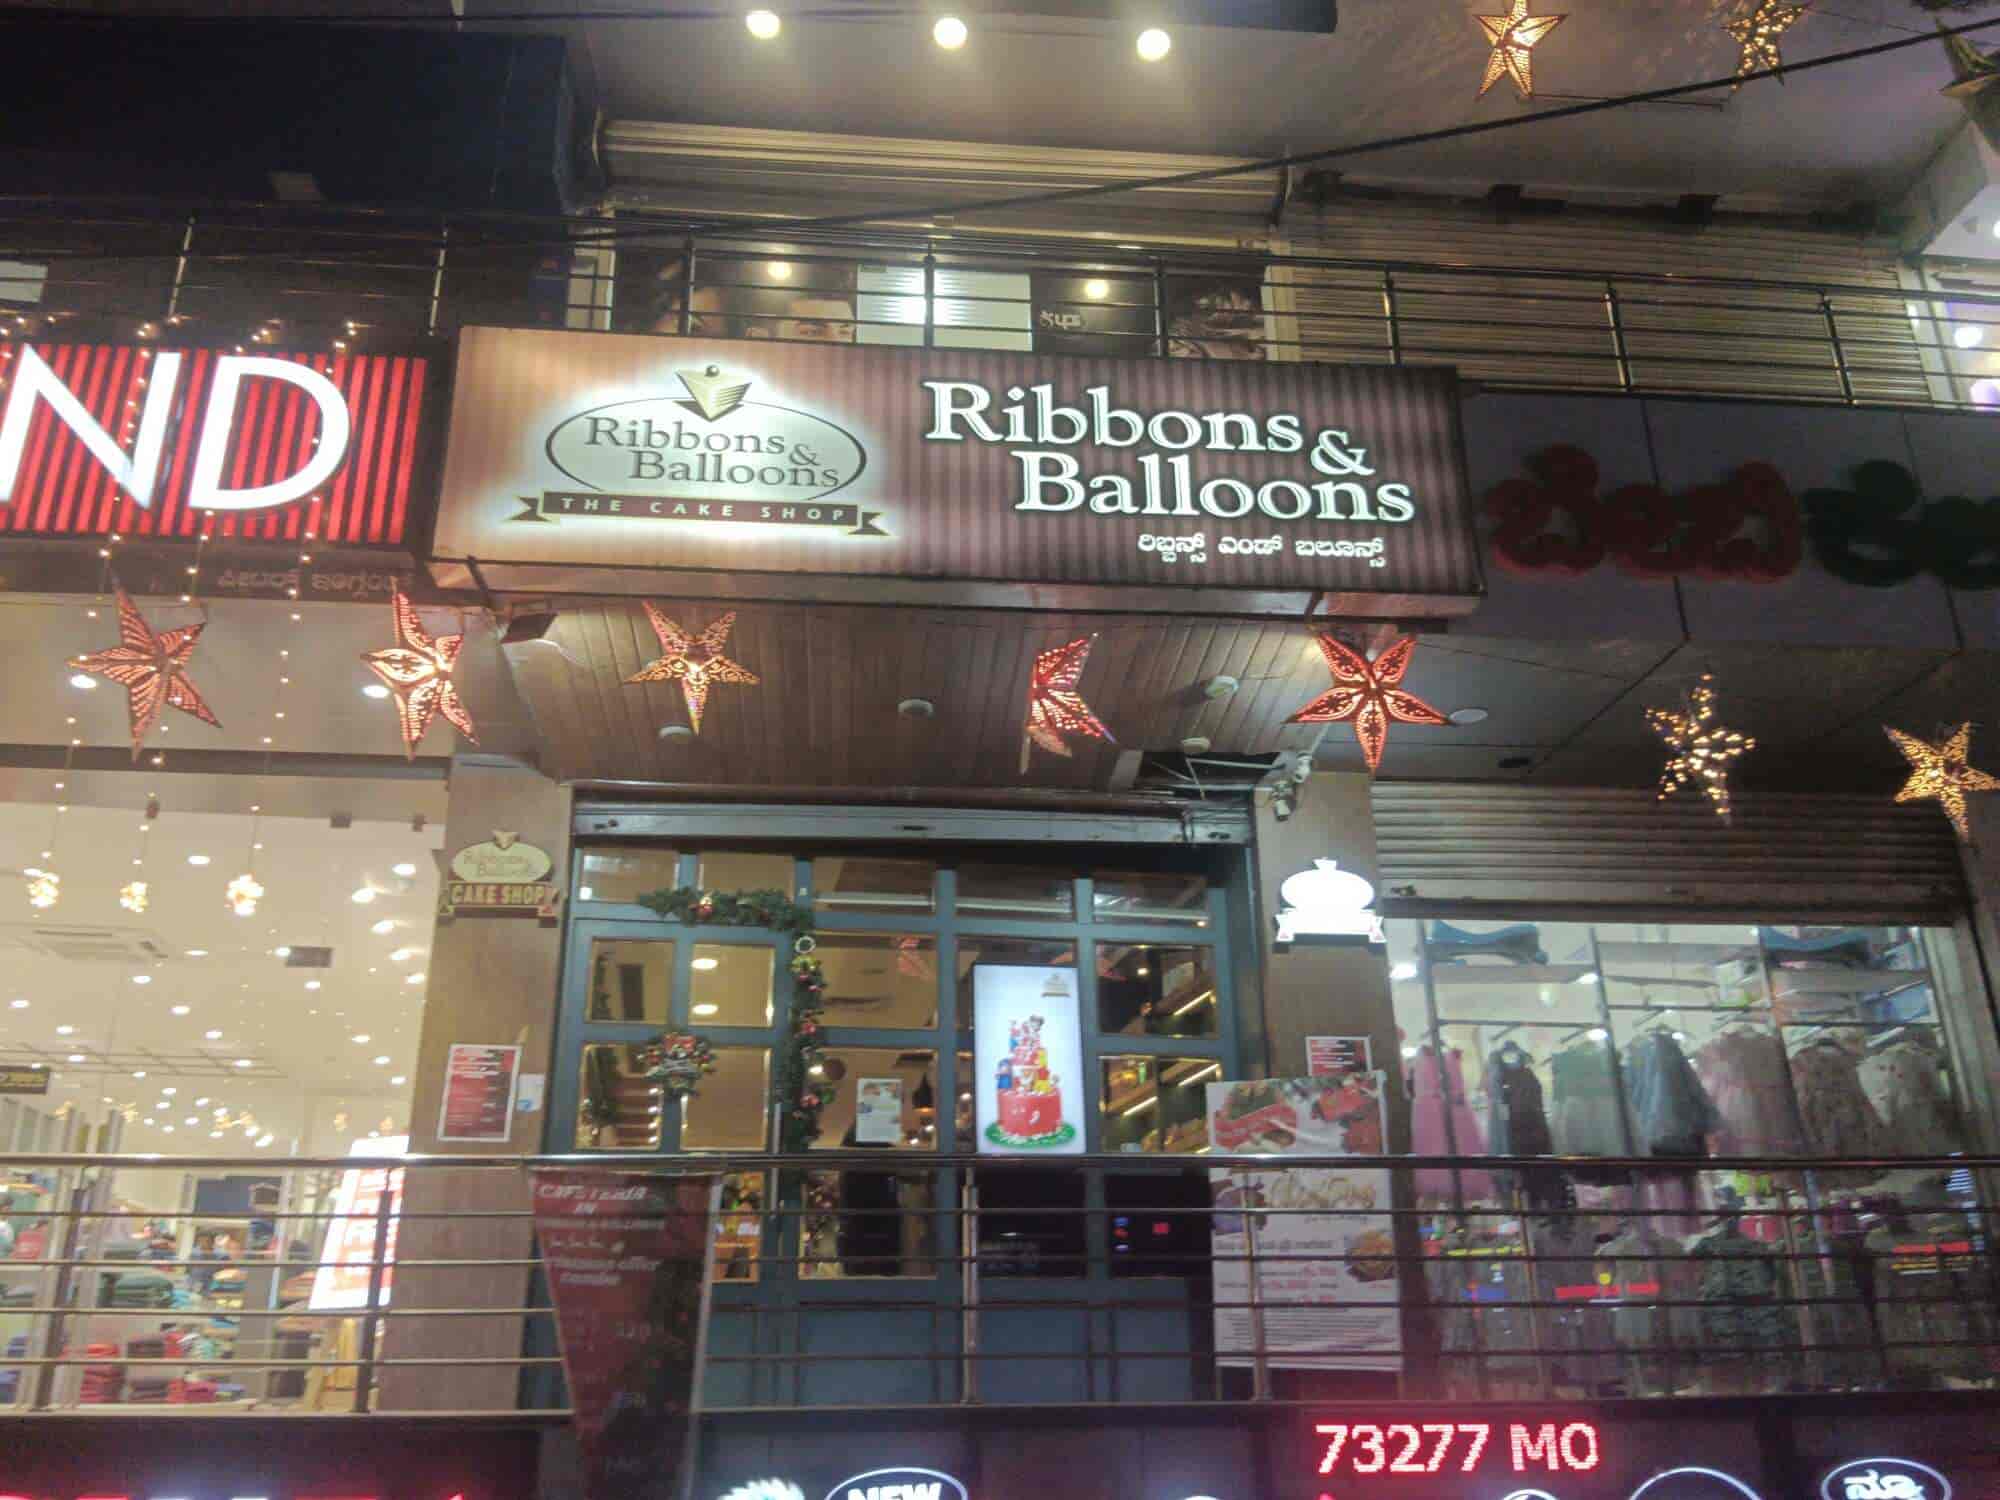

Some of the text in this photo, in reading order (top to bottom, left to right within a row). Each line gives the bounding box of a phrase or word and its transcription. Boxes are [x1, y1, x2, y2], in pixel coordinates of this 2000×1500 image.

[584, 416, 820, 467] Ribbons &
[922, 379, 1376, 476] Ribbons &
[627, 448, 839, 488] Balloons
[1010, 449, 1416, 523] Balloons
[561, 497, 847, 521] THE CAKE SHOP
[451, 884, 546, 906] CAKE SHOP
[1315, 1423, 1490, 1474] 73277
